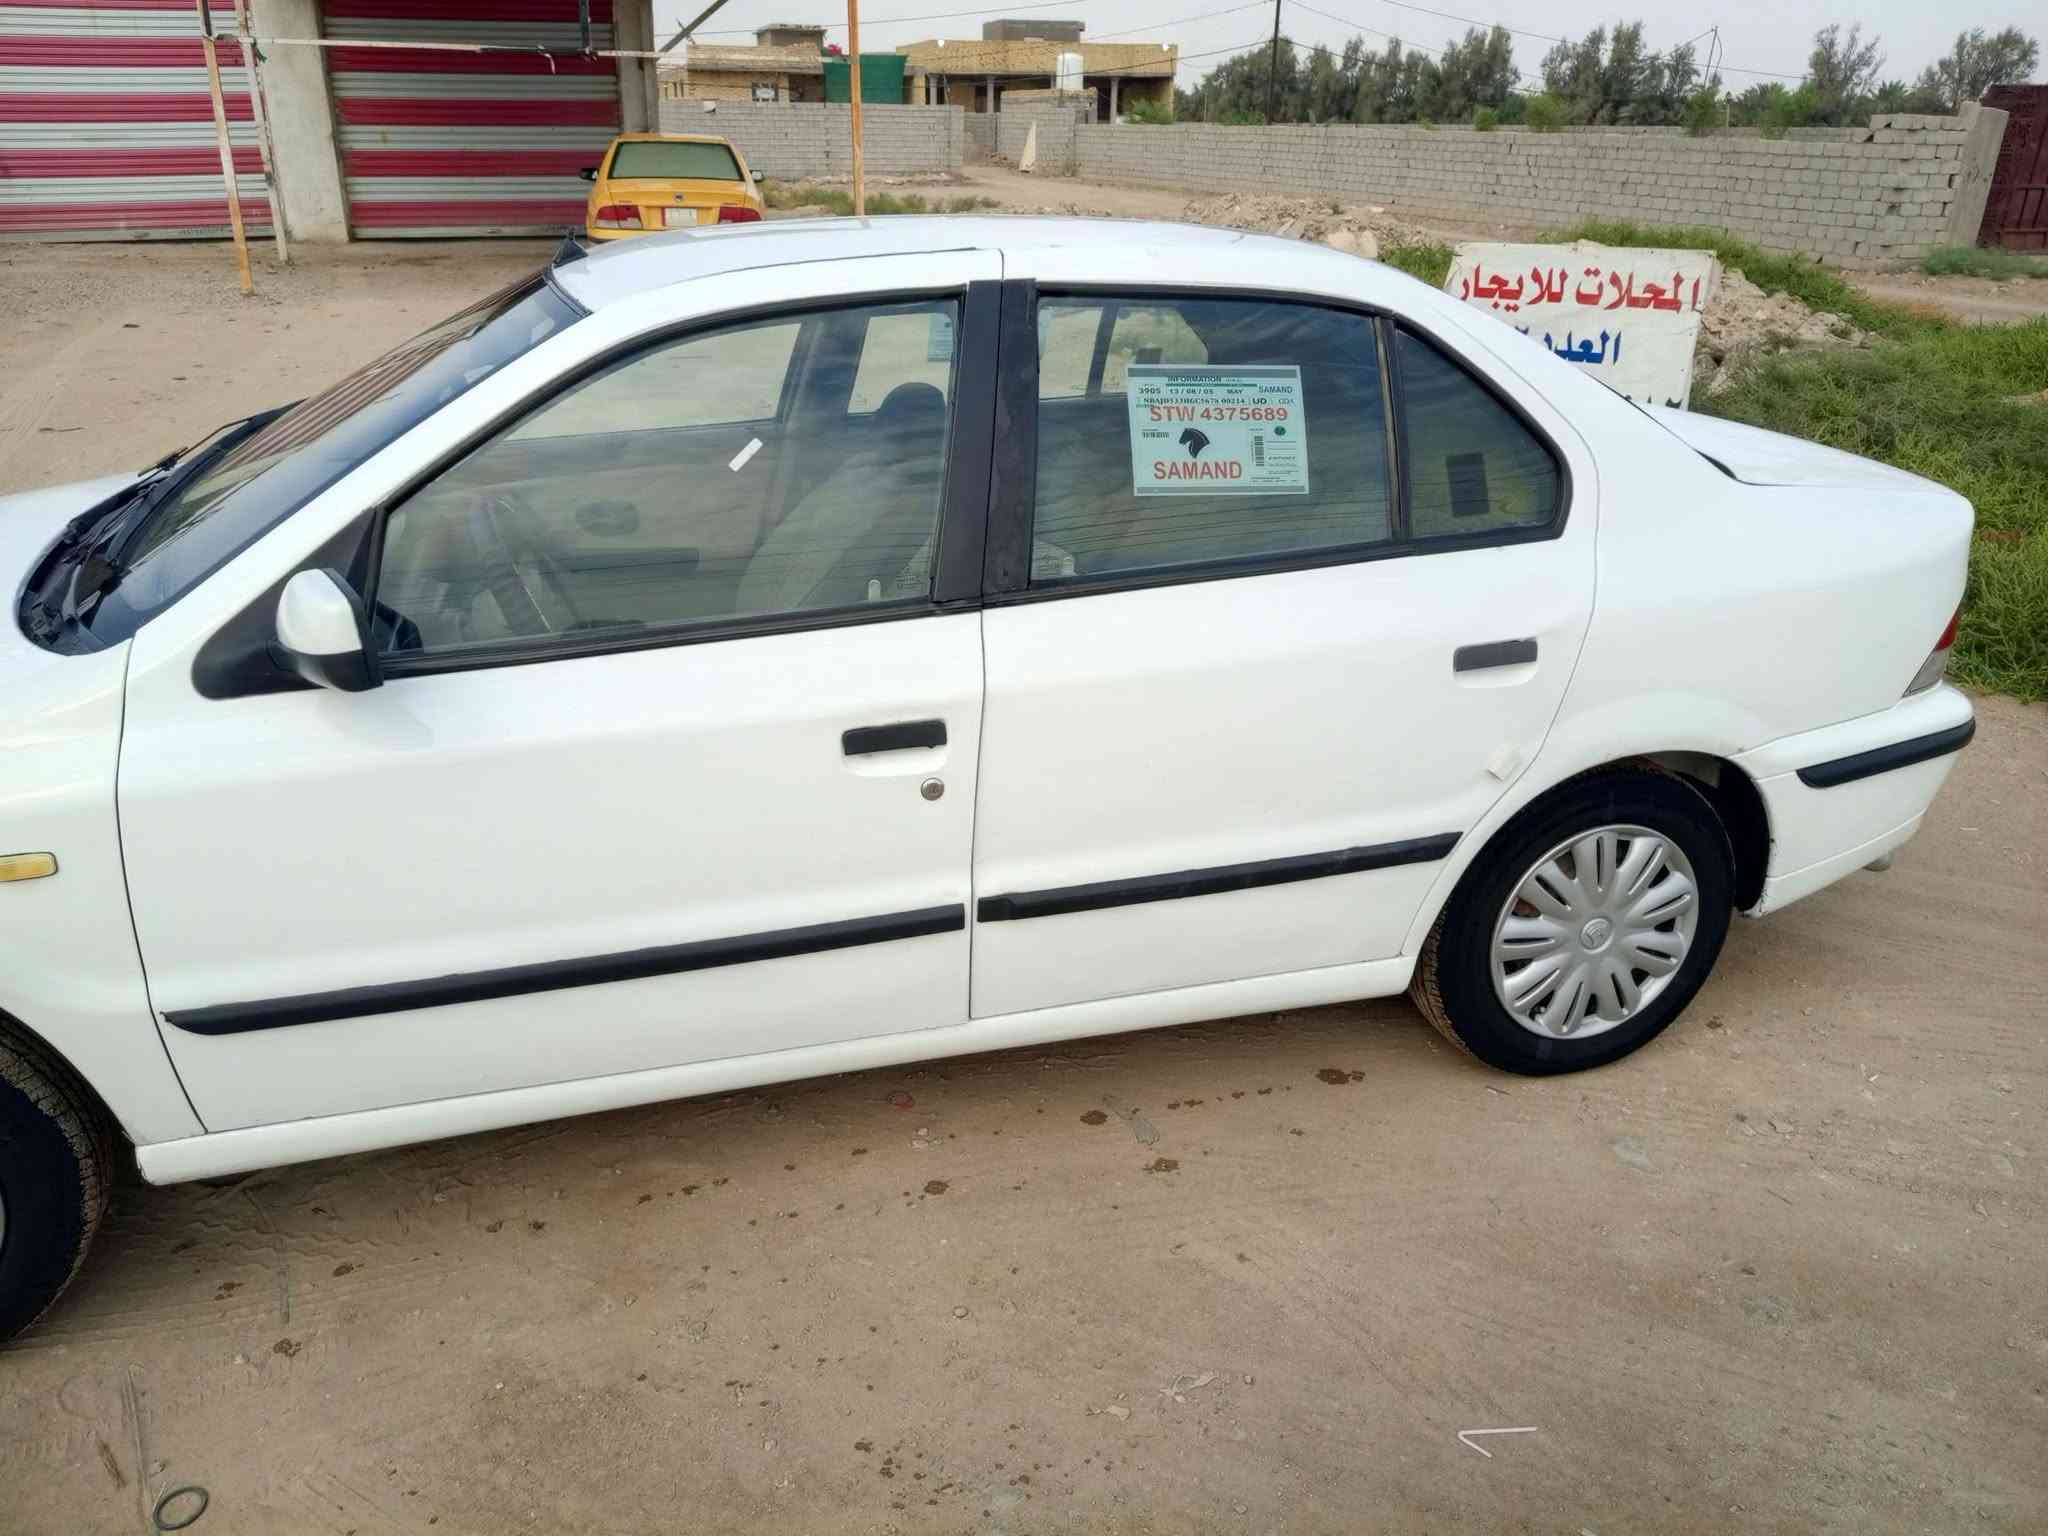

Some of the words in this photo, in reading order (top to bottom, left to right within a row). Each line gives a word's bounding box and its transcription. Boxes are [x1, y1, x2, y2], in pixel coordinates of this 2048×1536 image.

[1460, 263, 1569, 313] للايجار
[1575, 266, 1702, 313] المحلات
[1167, 375, 1222, 383] INFORMATION
[1258, 386, 1293, 394] SAMAND
[1150, 406, 1196, 422] STW
[1199, 407, 1288, 421] 4375689
[1153, 461, 1242, 480] SAMAND
